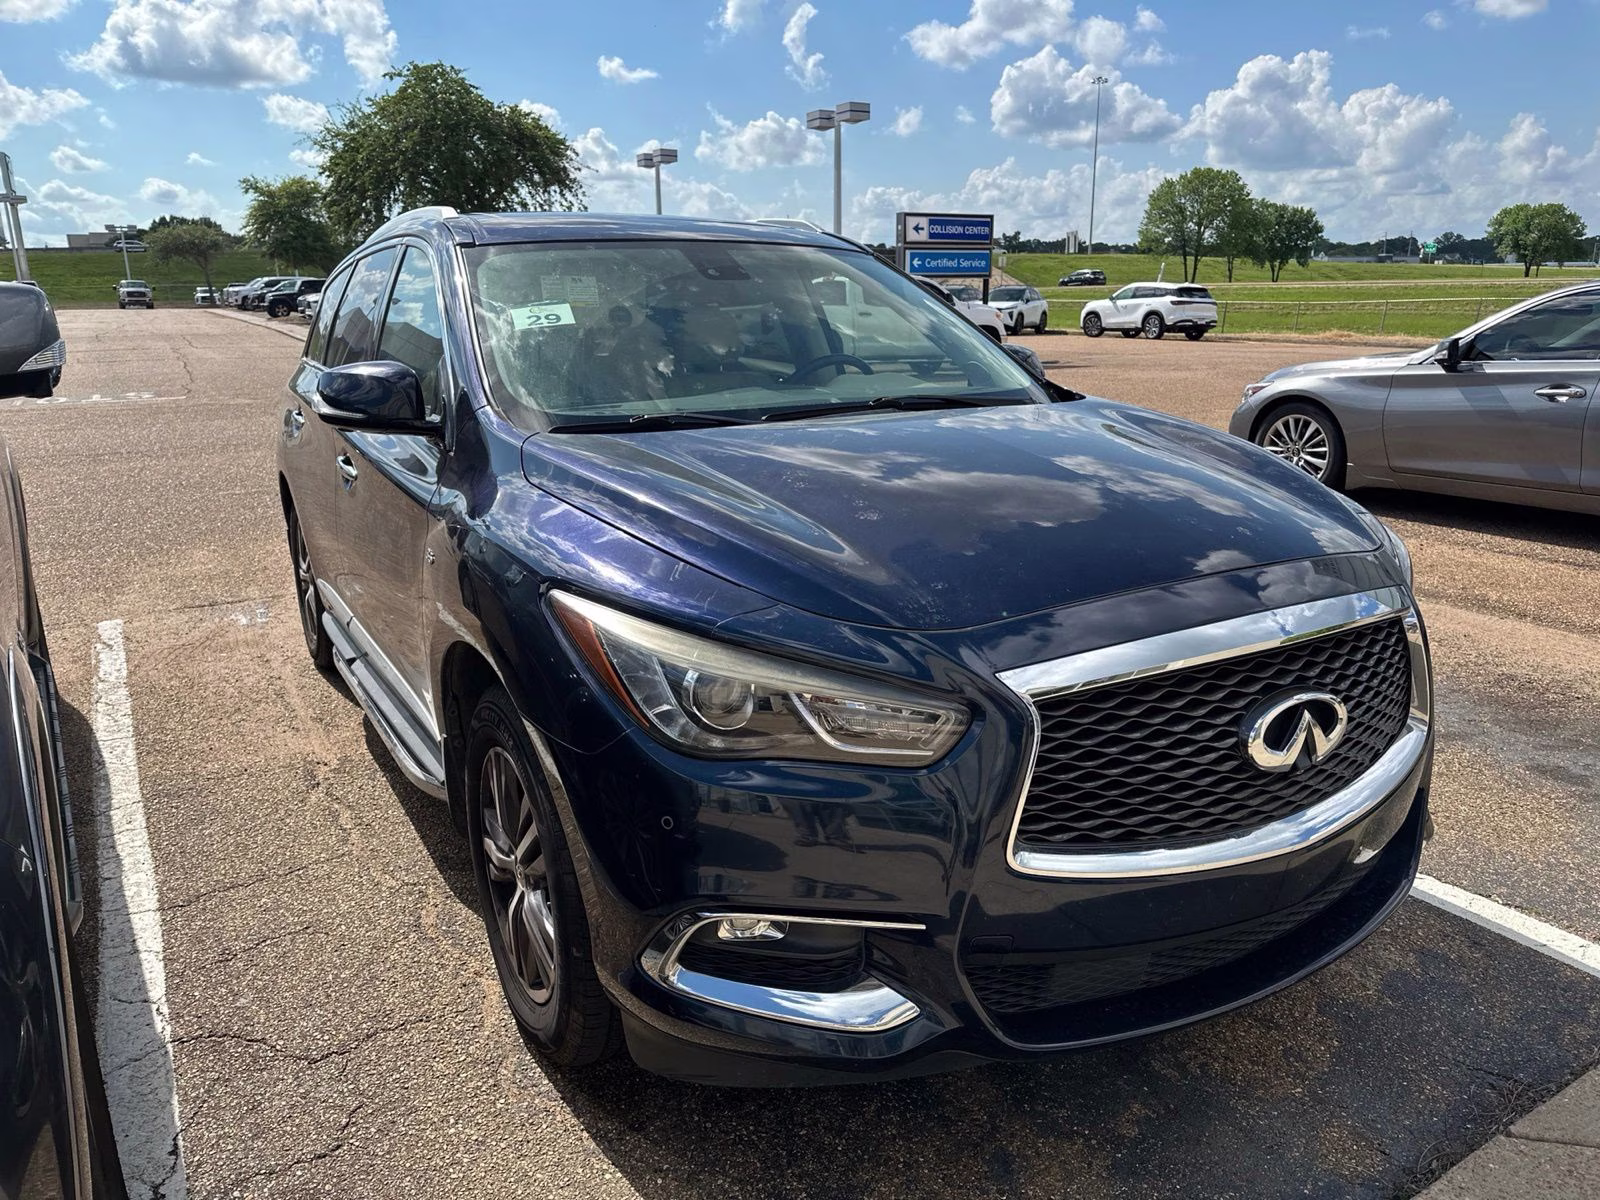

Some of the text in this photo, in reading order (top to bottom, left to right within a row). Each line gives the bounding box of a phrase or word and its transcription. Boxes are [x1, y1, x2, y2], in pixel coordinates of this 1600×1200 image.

[929, 225, 990, 235] COLLISION CENTER
[925, 258, 986, 267] Certified Service
[526, 313, 562, 326] 29
